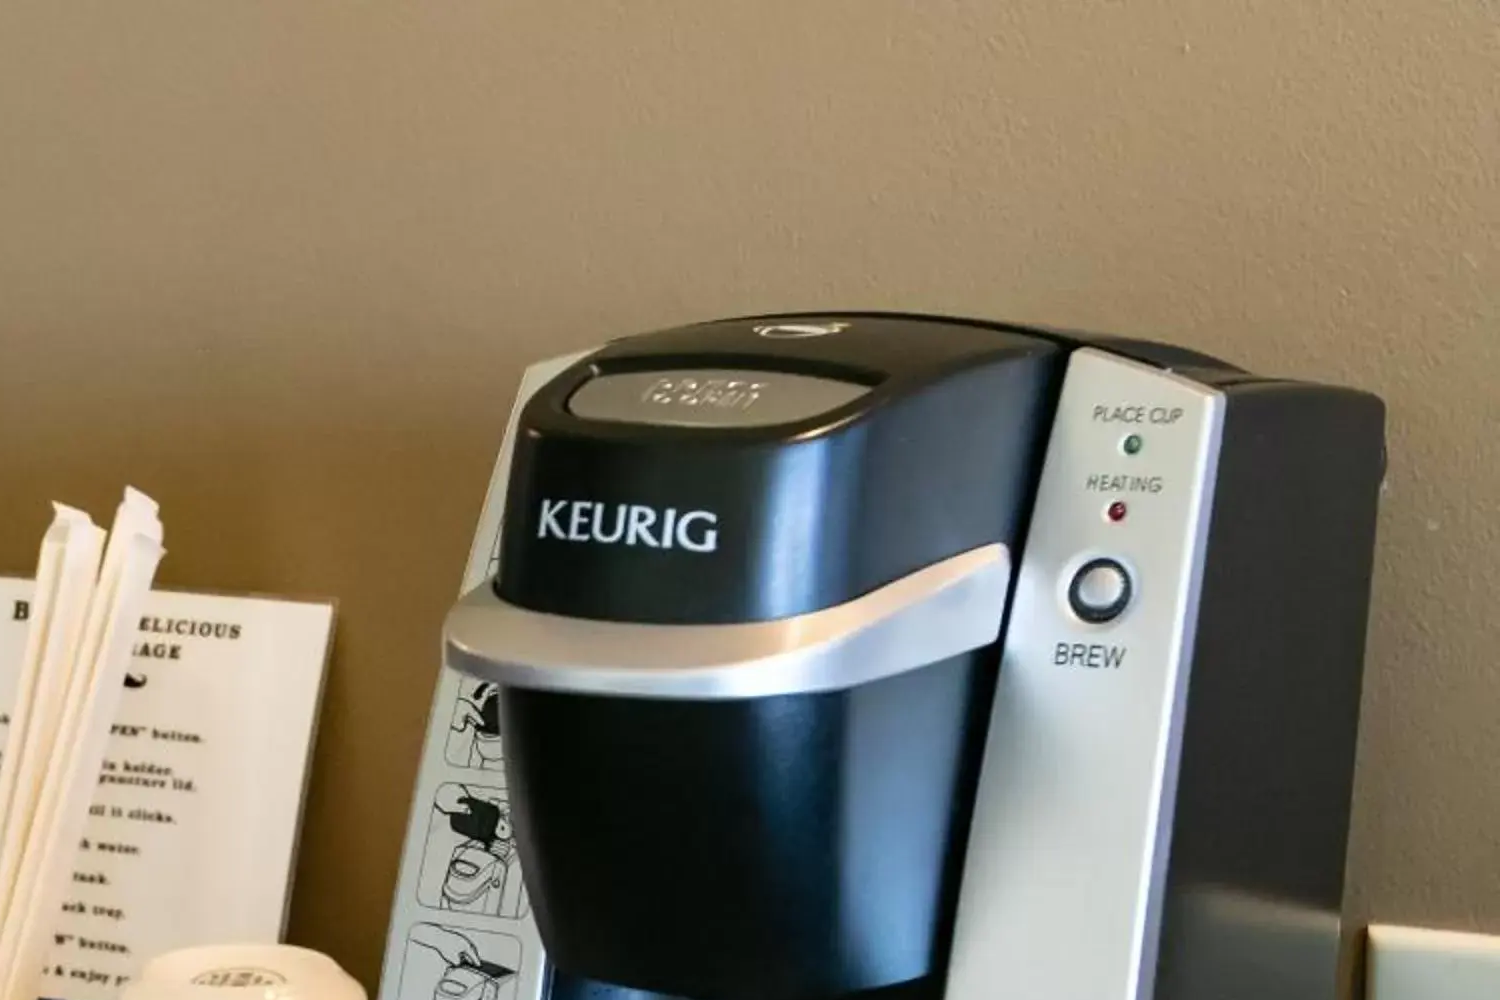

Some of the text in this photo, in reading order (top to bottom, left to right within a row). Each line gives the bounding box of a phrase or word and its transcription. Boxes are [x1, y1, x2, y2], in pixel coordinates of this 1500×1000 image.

[1092, 406, 1185, 425] PLACE CUP
[1086, 474, 1164, 493] HEATING
[537, 498, 717, 553] KEURIG
[138, 616, 242, 640] ELICIOUS
[132, 642, 182, 660] AGE
[1054, 642, 1128, 669] BREW
